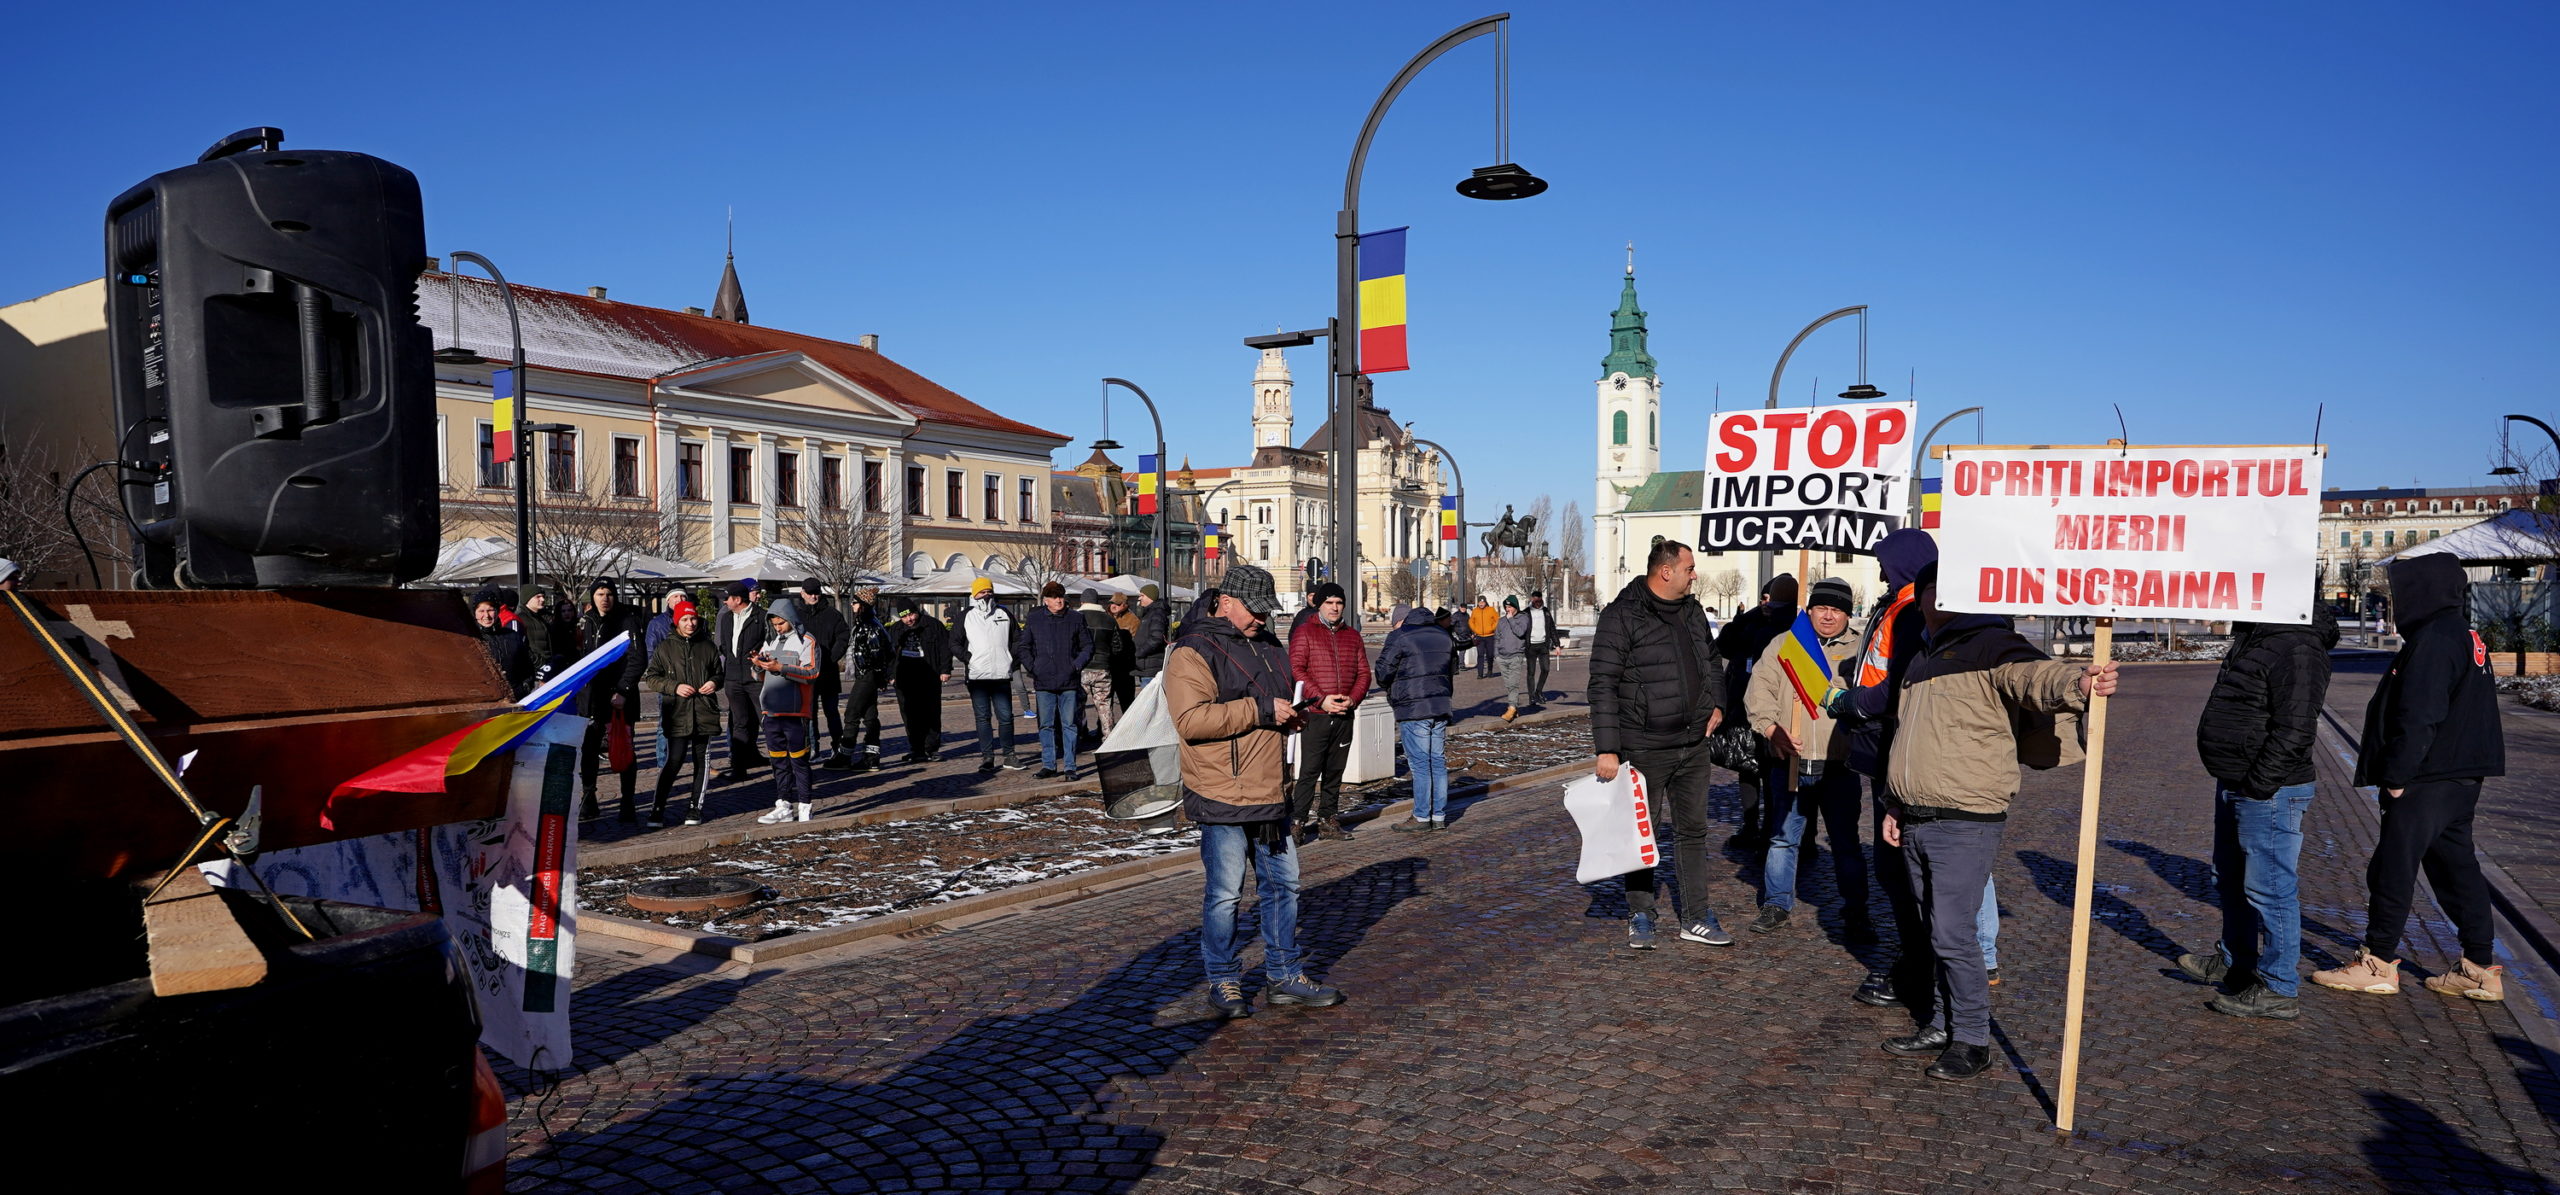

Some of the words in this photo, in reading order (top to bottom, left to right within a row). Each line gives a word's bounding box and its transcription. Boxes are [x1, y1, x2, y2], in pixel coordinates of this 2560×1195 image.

[1715, 407, 1907, 473] STOP
[1710, 472, 1901, 511] IMPORT
[1954, 459, 2082, 508] OPRIȚI
[2093, 458, 2308, 498] IMPORTUL
[1707, 515, 1889, 551] UCRAINA
[2054, 514, 2186, 552] MIERII
[1978, 567, 2045, 604] DIN
[2056, 567, 2239, 610] UCRAINA
[2251, 572, 2266, 611] !
